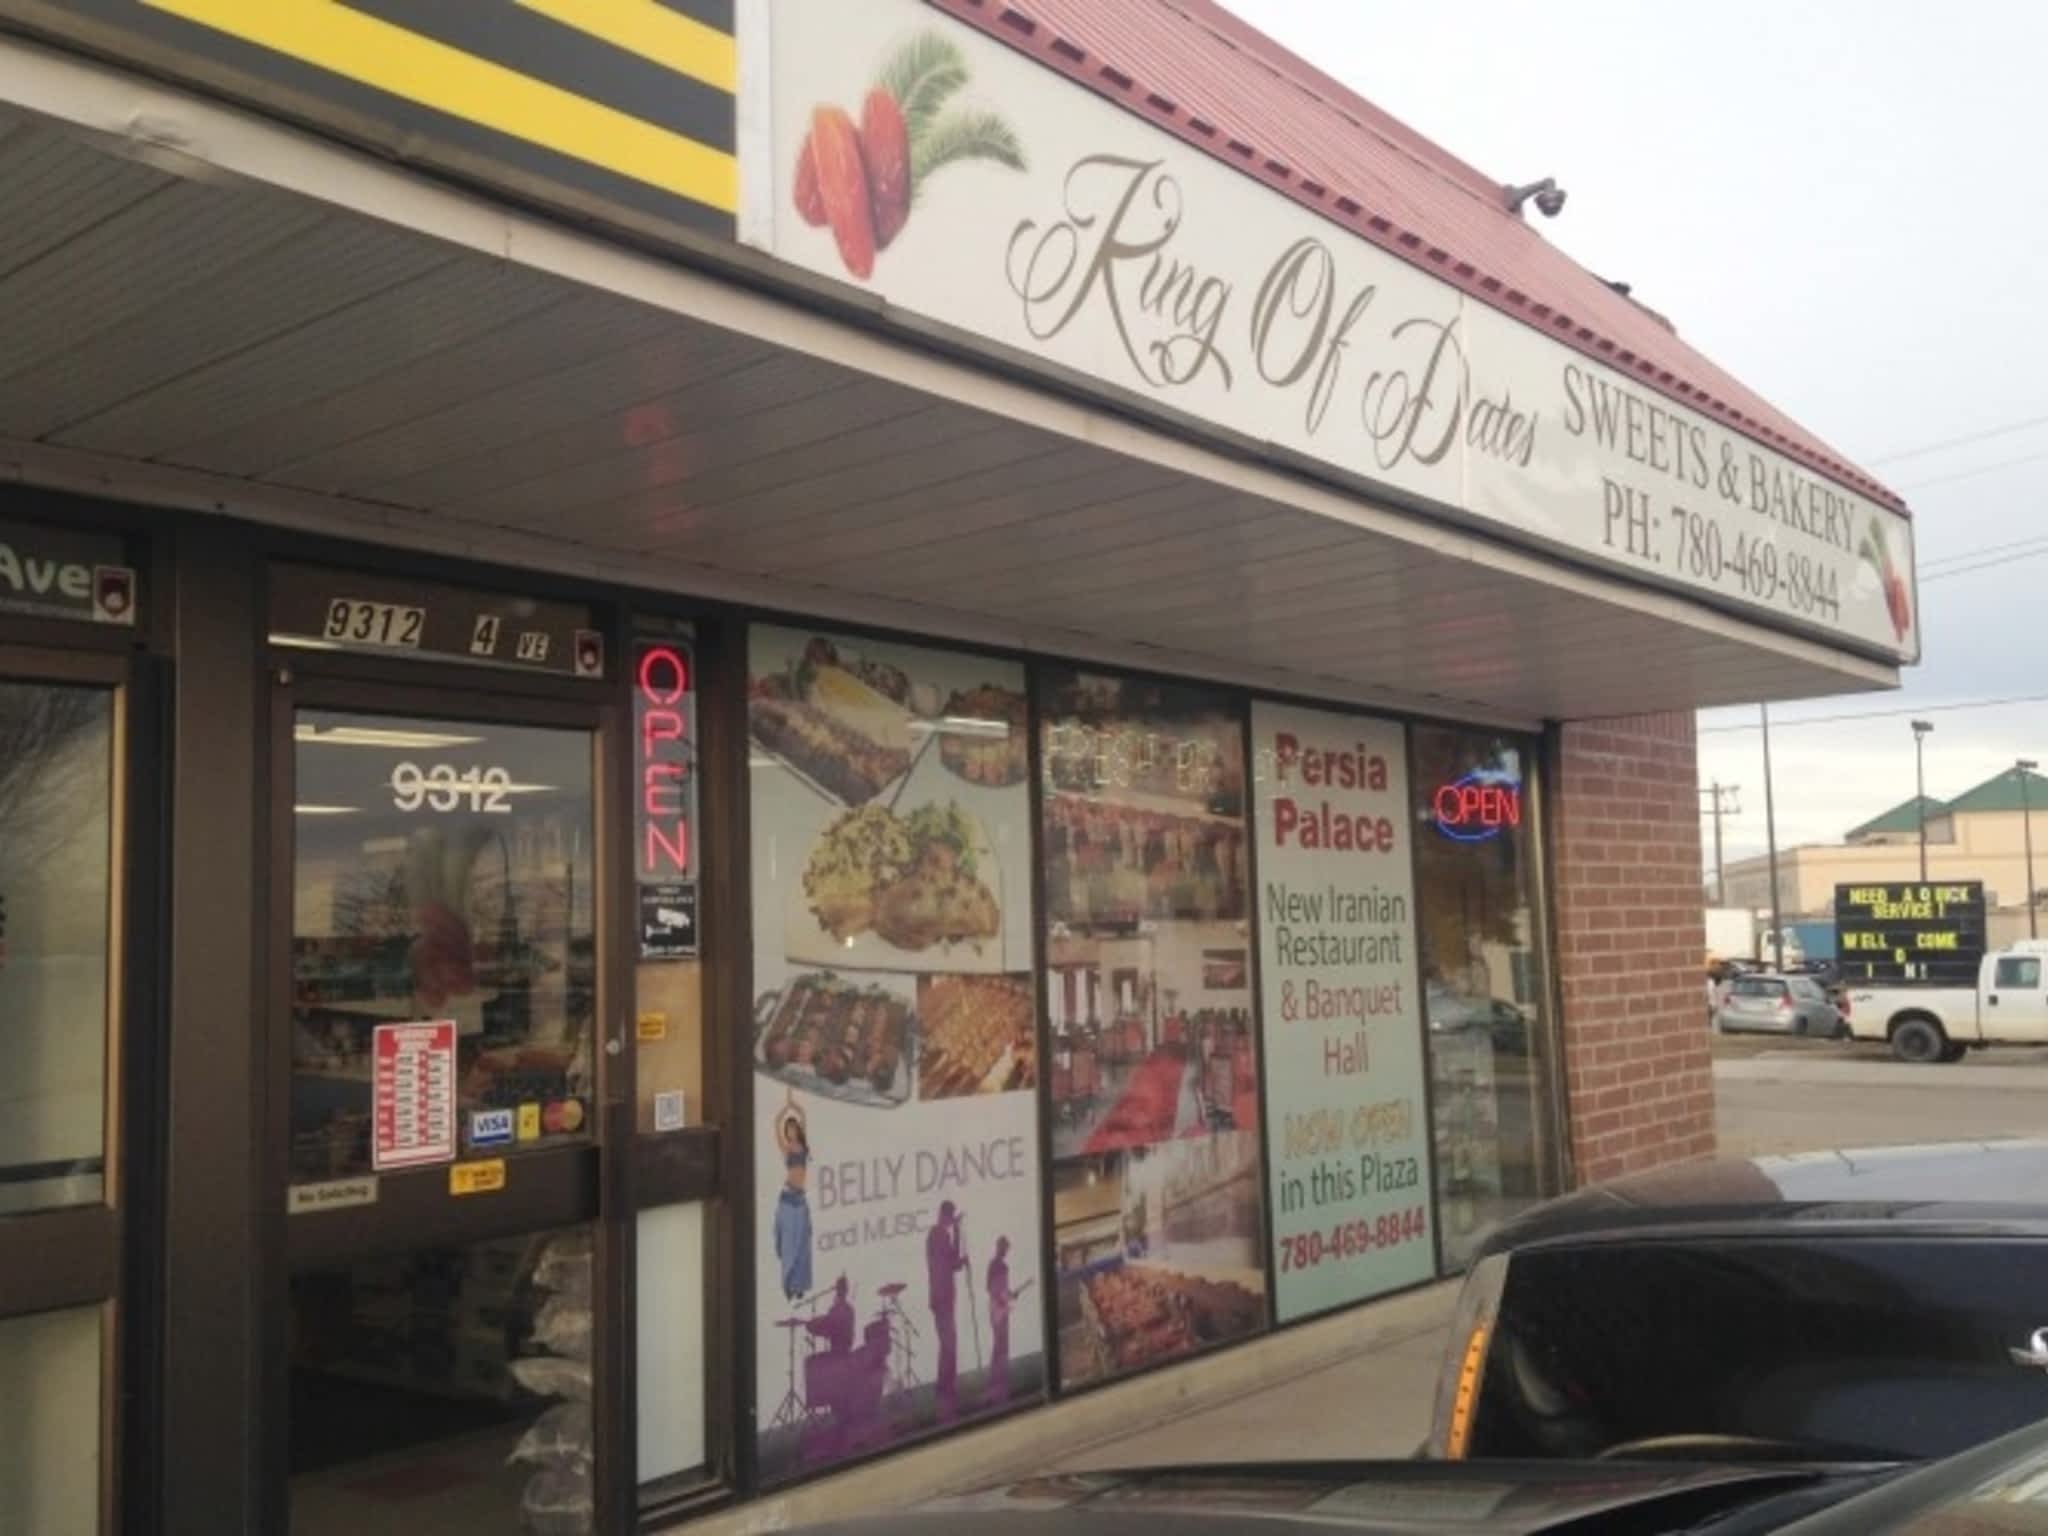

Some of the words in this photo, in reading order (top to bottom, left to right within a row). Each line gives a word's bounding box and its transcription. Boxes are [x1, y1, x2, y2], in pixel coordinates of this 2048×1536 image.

[1005, 153, 1233, 389] King
[1250, 236, 1376, 436] Of
[1361, 315, 1540, 471] Dates
[1563, 363, 1710, 491] SWEETS
[1717, 441, 1742, 507] &
[1748, 452, 1856, 554] BAKERY
[1601, 476, 1662, 564] PH:
[1671, 505, 1840, 624] 780-469-8844
[326, 602, 424, 646] 9312
[473, 618, 494, 653] 4
[637, 648, 689, 871] OPEN
[1274, 731, 1388, 792] Persia
[391, 761, 512, 812] 9312
[1434, 784, 1522, 828] OPEN
[1273, 796, 1394, 853] Palace
[1266, 882, 1323, 924] New
[1328, 883, 1406, 924] Iranian
[1849, 887, 1888, 905] NEED
[1902, 887, 1913, 902] A
[1872, 901, 1932, 919] SERVICE
[1275, 925, 1403, 967] Restaurant
[1842, 932, 1887, 949] WELL
[1916, 931, 1958, 949] COME
[1280, 979, 1298, 1022] &
[1305, 978, 1403, 1026] Banquet
[1322, 1030, 1369, 1077] Hall
[476, 1114, 509, 1133] VISA
[817, 1153, 906, 1211] BELLY
[914, 1136, 1025, 1194] DANCE
[1281, 1169, 1304, 1213] in
[1310, 1160, 1355, 1206] this
[1360, 1152, 1418, 1195] Plaza
[818, 1222, 858, 1251] and
[863, 1210, 929, 1241] MUSIC
[1280, 1204, 1426, 1274] 780-469-8844
